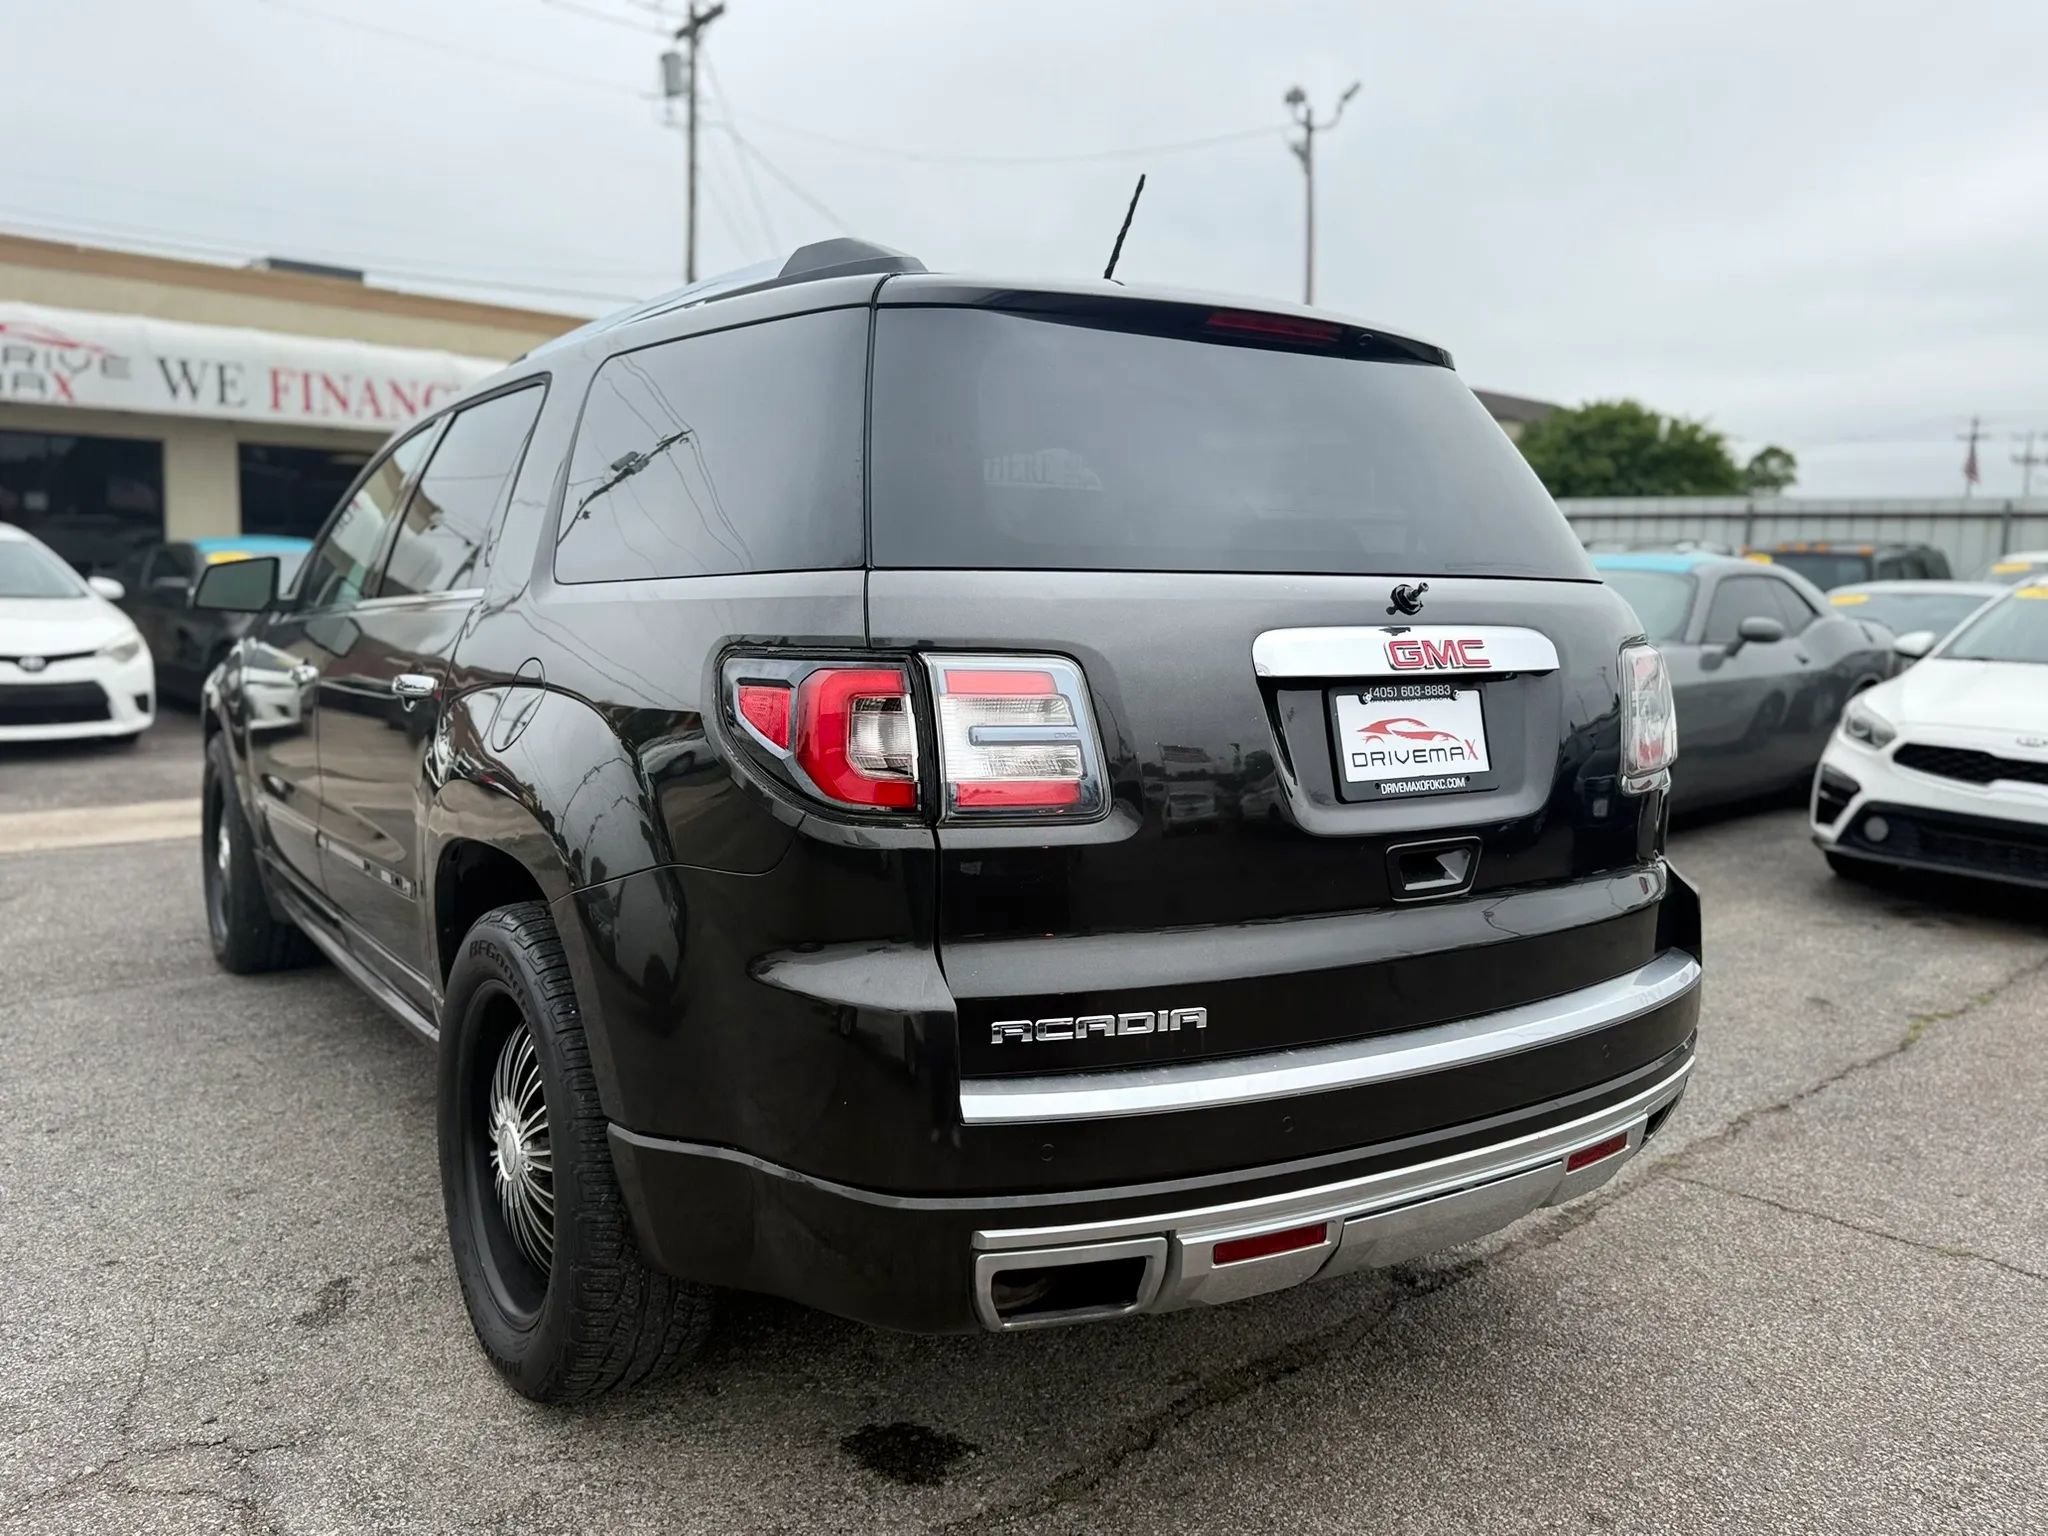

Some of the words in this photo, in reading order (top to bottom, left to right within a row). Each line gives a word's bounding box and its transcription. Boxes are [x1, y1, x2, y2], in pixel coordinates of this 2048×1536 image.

[2, 345, 131, 380] RIVE
[0, 371, 74, 404] AX
[157, 356, 247, 408] WE
[269, 366, 463, 419] FINANC
[1385, 639, 1492, 670] GMC
[1369, 686, 1397, 698] (405)
[1401, 684, 1451, 697] 603-8883
[1352, 739, 1479, 768] DRIVEMAX
[1380, 777, 1466, 795] DRIVEMAXOFOKC.COM
[990, 1007, 1208, 1044] ACADIA
